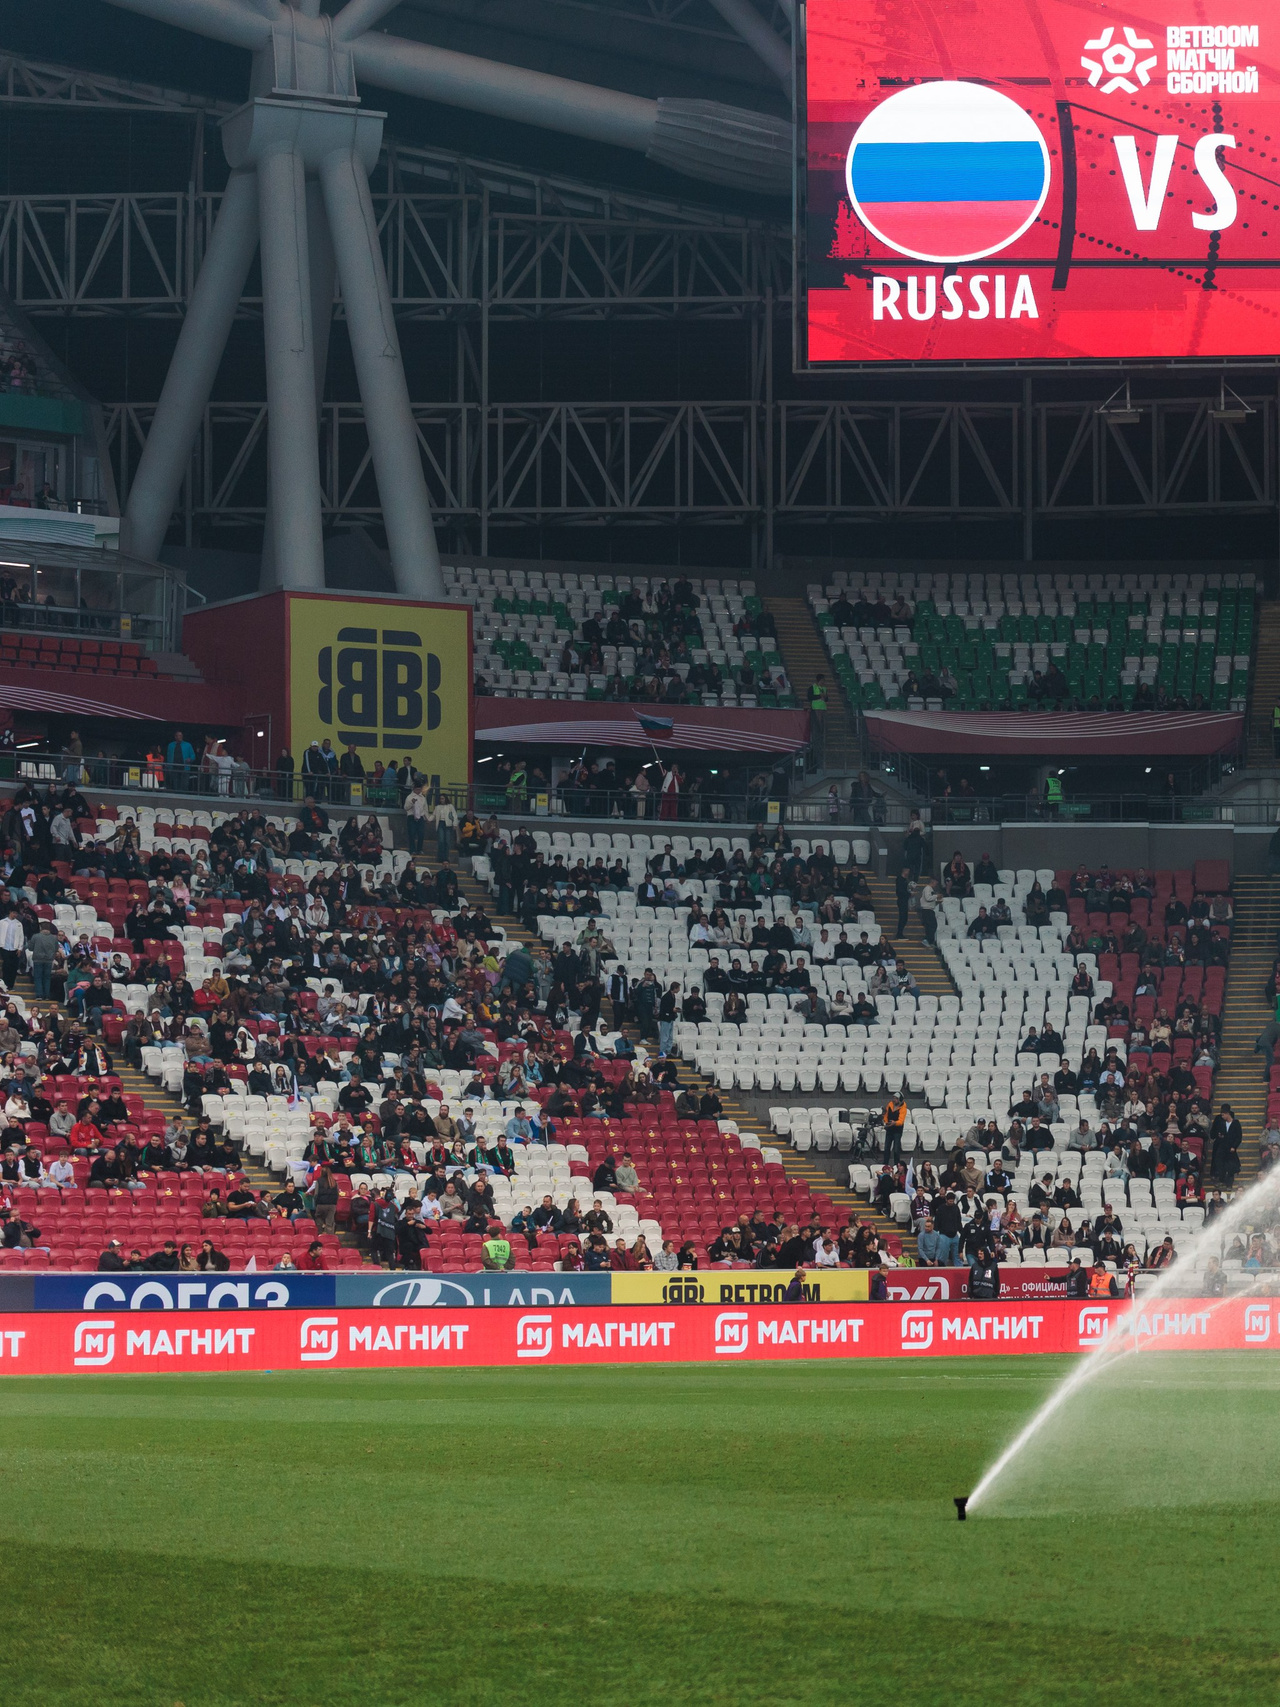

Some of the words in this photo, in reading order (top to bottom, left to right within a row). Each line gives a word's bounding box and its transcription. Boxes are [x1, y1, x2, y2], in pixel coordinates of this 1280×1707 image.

[1166, 25, 1259, 48] BETBOOM
[1166, 48, 1235, 71] МАТЧИ
[1166, 66, 1259, 94] СБОРНОЙ
[1114, 133, 1237, 232] VS
[872, 274, 1039, 321] RUSSIA
[720, 1284, 821, 1302] BETBOM
[562, 1322, 675, 1347] МАГНИТ
[758, 1319, 863, 1344] МАГНИТ
[942, 1316, 1043, 1340] МАГНИТ
[1117, 1313, 1211, 1335] МАГНИТ
[127, 1328, 255, 1355] МАГНИТ
[349, 1325, 469, 1350] МАГНИТ
